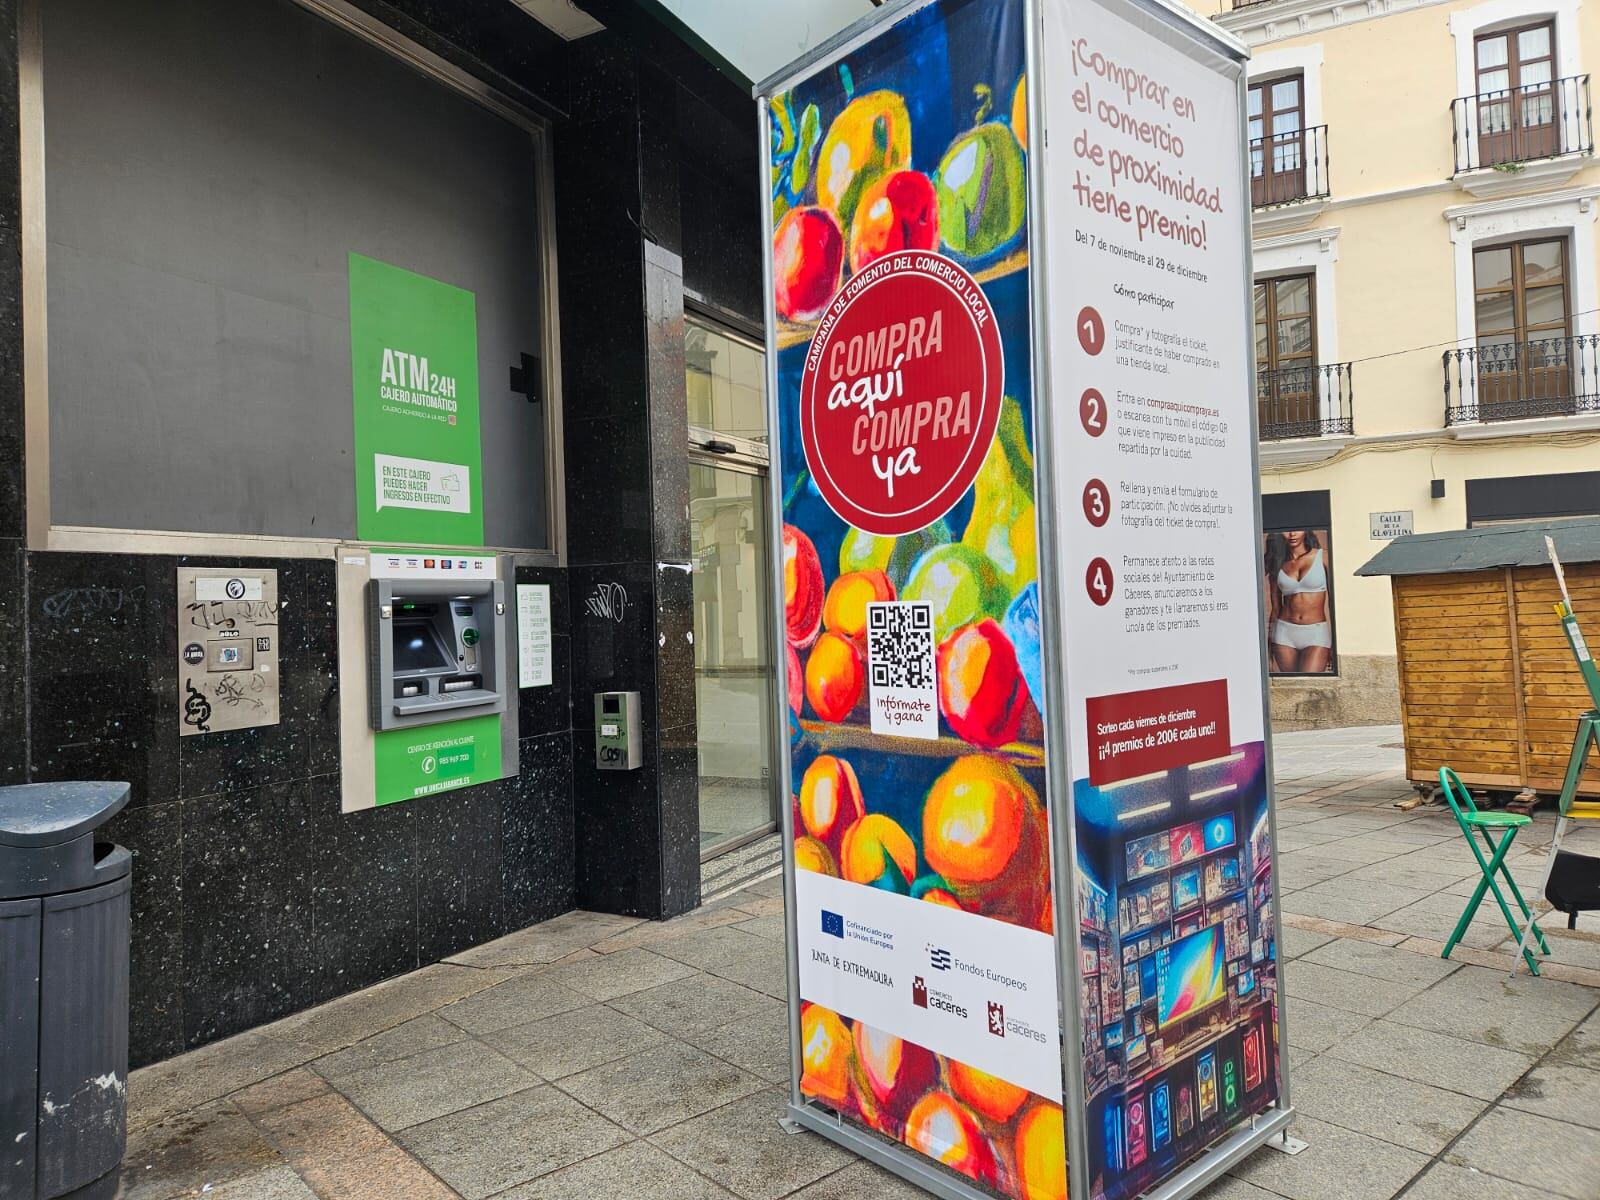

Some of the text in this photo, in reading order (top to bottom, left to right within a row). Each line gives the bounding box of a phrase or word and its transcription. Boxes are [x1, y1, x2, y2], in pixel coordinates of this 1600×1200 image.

[1072, 38, 1195, 122] ¡Comprar en
[1072, 82, 1184, 158] el comercio
[1074, 128, 1223, 213] de proximidad
[1073, 170, 1206, 250] tiene premio!
[1076, 229, 1208, 283] Del 7 de noviembre al 29 de diciembre
[1114, 283, 1175, 311] Cómo participar
[808, 257, 988, 371] CAMPAÑA DE FOMENTO DEL COMERCIO LOCAL
[1083, 320, 1095, 344] 1
[829, 310, 942, 381] COMPRA
[1154, 344, 1162, 356] de
[1164, 348, 1181, 360] haber
[1183, 353, 1211, 368] comprado
[381, 348, 455, 398] ATM 24H
[1116, 355, 1128, 366] una
[1130, 356, 1151, 370] tienda
[828, 353, 904, 418] aquí
[381, 386, 457, 412] CAJERO AUTOMÁTICO
[383, 405, 401, 414] CAJERO
[1117, 390, 1135, 404] Entra
[1137, 396, 1145, 406] en
[852, 392, 970, 456] COMPRA
[1088, 398, 1100, 428] 2
[1124, 410, 1150, 423] escanea
[1152, 415, 1163, 424] con
[1166, 415, 1172, 426] tu
[1192, 417, 1197, 429] el
[1199, 420, 1218, 434] código
[1220, 423, 1227, 433] QR
[1118, 426, 1225, 447] que viene impreso en la publicidad
[1119, 442, 1148, 455] repartida
[1150, 447, 1160, 458] por
[1163, 445, 1168, 456] la
[383, 466, 430, 480] EN ESTE CAJERO
[384, 478, 427, 491] PUEDES HACER
[872, 447, 920, 498] ya
[384, 489, 450, 504] INGRESOS EN EFECTIVO
[1120, 481, 1145, 494] Rellena
[1171, 486, 1177, 495] el
[1179, 486, 1209, 498] formulario
[1210, 488, 1218, 499] de
[1089, 487, 1104, 518] 3
[1181, 501, 1201, 513] olvides
[1202, 503, 1227, 515] adjuntar
[1228, 504, 1233, 514] la
[1121, 514, 1152, 528] fotografía
[1154, 516, 1164, 527] del
[1166, 517, 1184, 527] ticket
[1185, 517, 1193, 528] de
[1123, 555, 1215, 567] Permanece atento a las redes
[1093, 567, 1107, 598] 4
[1124, 570, 1214, 584] sociales del Ayuntamiento de
[1154, 588, 1198, 599] anunciaremos
[1204, 586, 1213, 596] los
[1125, 601, 1228, 618] ganadores te llamaremos si eres
[1146, 620, 1154, 632] de
[1156, 620, 1166, 631] los
[885, 712, 923, 725] y gana
[1097, 709, 1196, 736] Sorteo cada viernes de diciembre
[1112, 737, 1143, 757] premios
[1145, 734, 1155, 747] de
[1157, 729, 1178, 745] 200€
[1180, 726, 1197, 739] cada
[846, 920, 893, 940] Cofinanciado por
[853, 931, 868, 942] Unión
[870, 936, 893, 950] Europea
[812, 949, 893, 987] JUNTA DE EXTREMADURA
[955, 960, 1027, 991] Fondos Europeos
